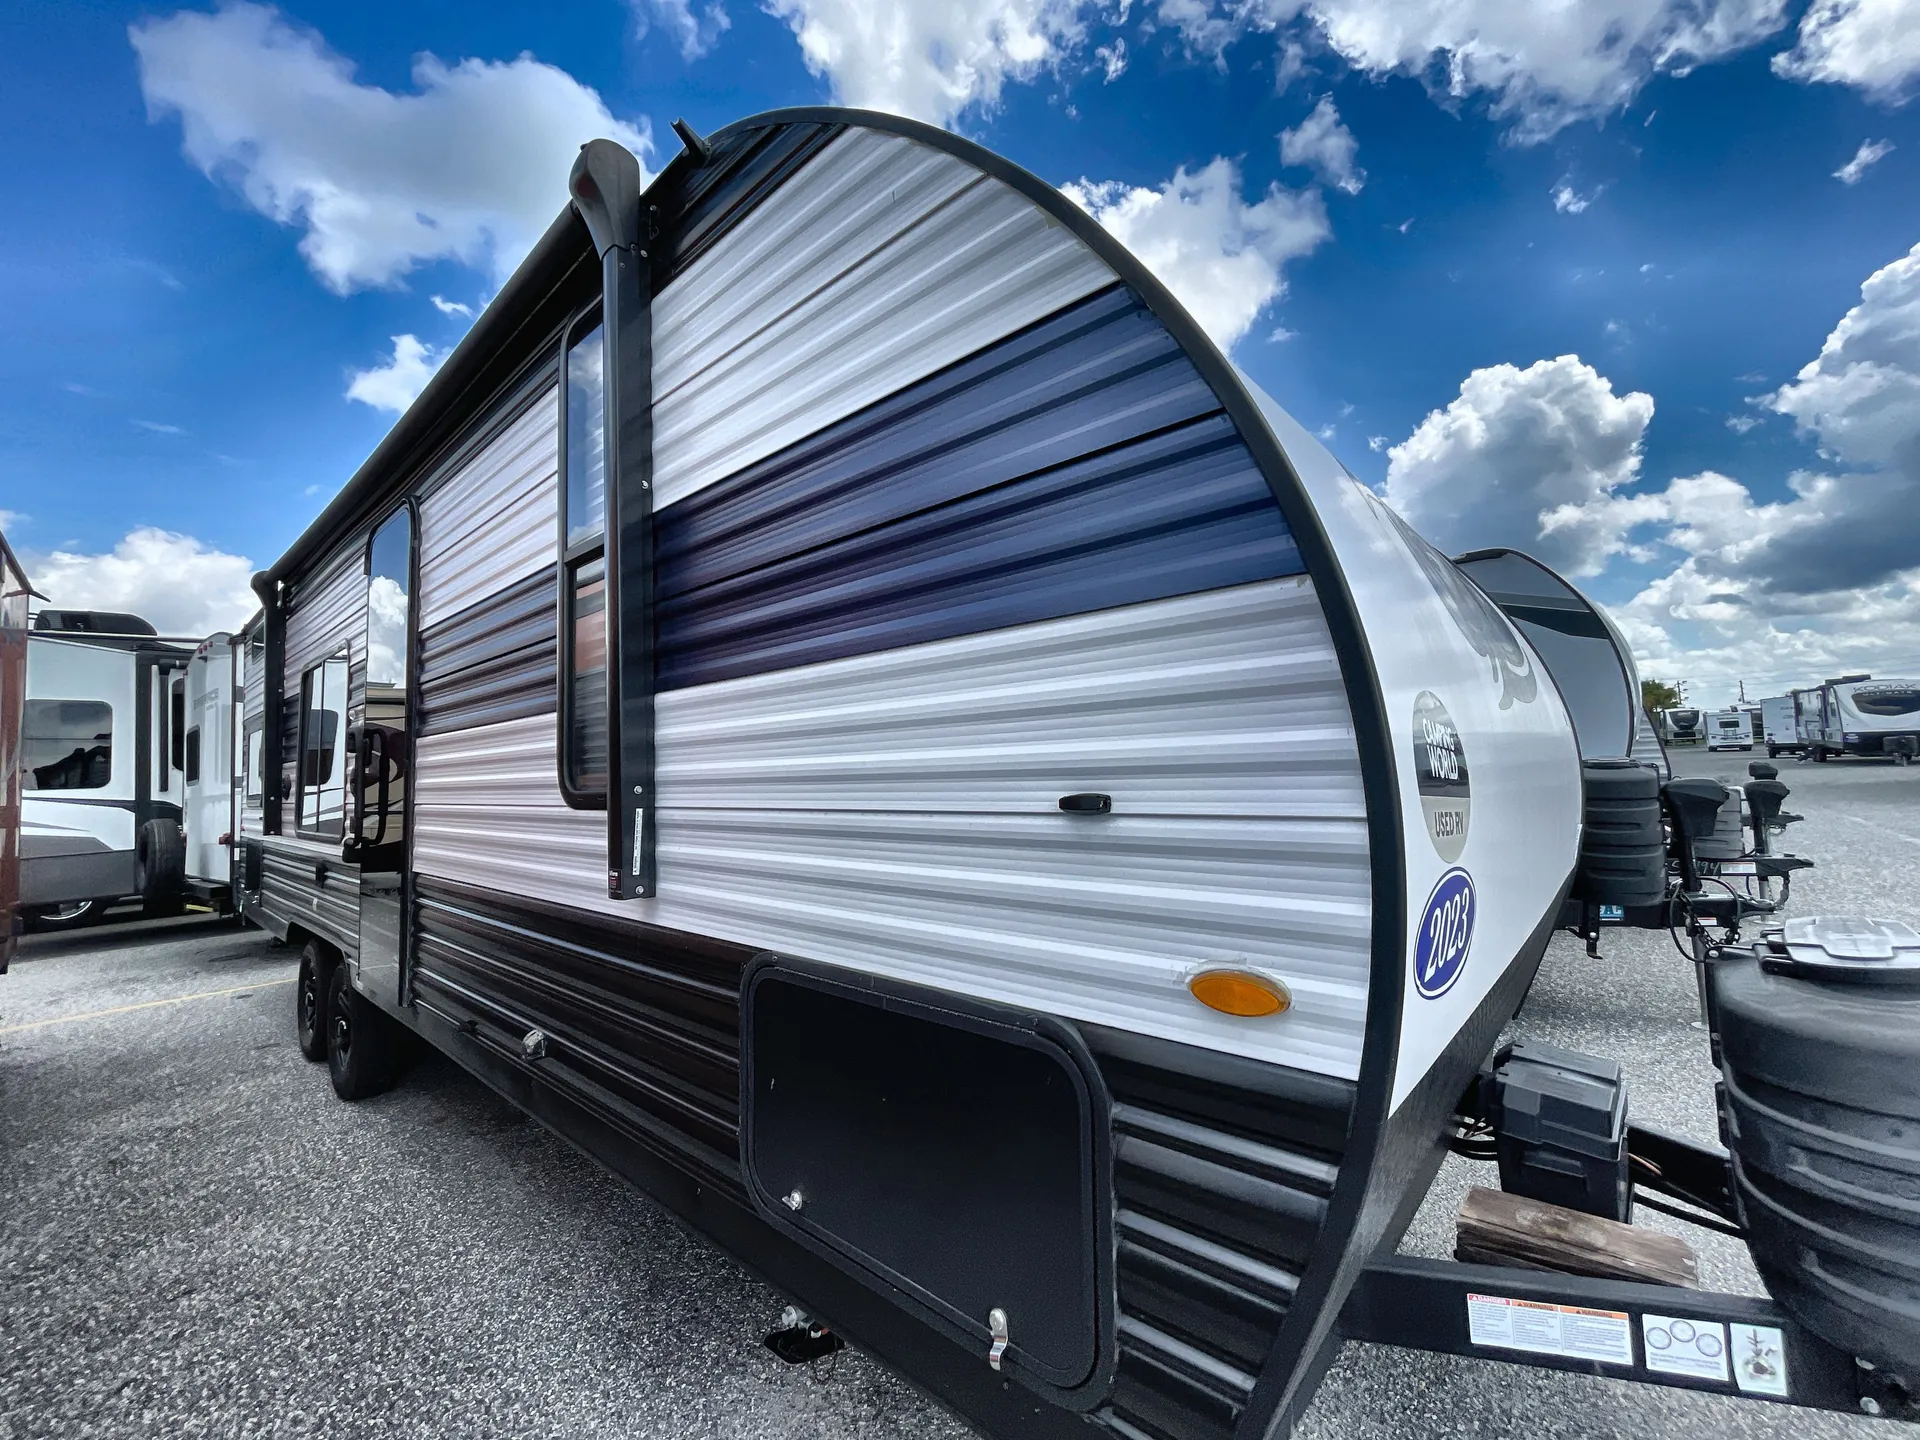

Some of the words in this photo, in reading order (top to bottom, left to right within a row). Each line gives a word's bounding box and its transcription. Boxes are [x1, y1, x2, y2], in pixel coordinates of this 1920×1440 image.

[1853, 684, 1916, 692] KODIAK
[1422, 717, 1455, 752] CAMPING
[1426, 744, 1459, 781] WORLD
[1434, 811, 1455, 838] USED
[1455, 811, 1465, 836] RV
[1424, 887, 1470, 983] 2023
[1478, 1295, 1507, 1305] DANGER
